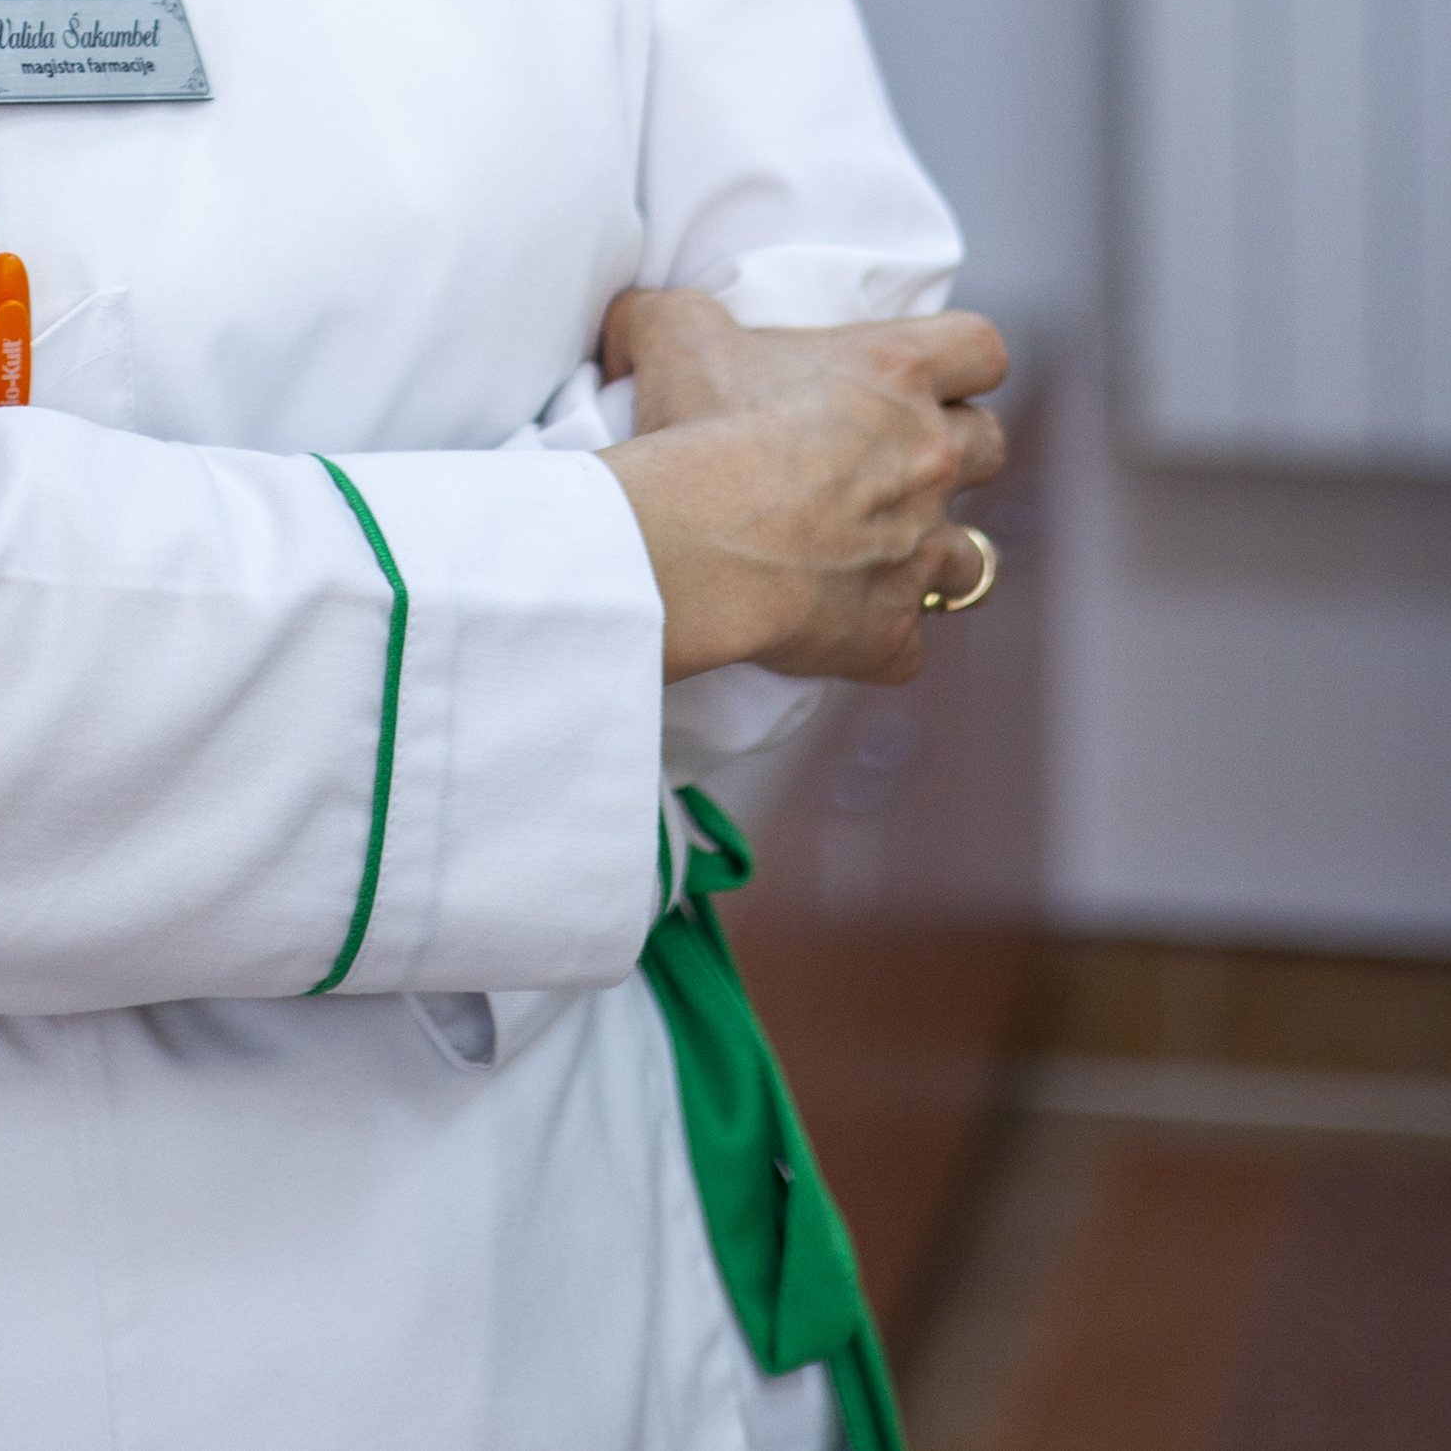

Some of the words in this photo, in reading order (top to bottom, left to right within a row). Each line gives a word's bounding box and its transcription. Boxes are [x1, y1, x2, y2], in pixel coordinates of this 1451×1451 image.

[21, 58, 85, 77] magistra
[87, 57, 156, 76] farmacije
[0, 337, 23, 406] io-Kult
